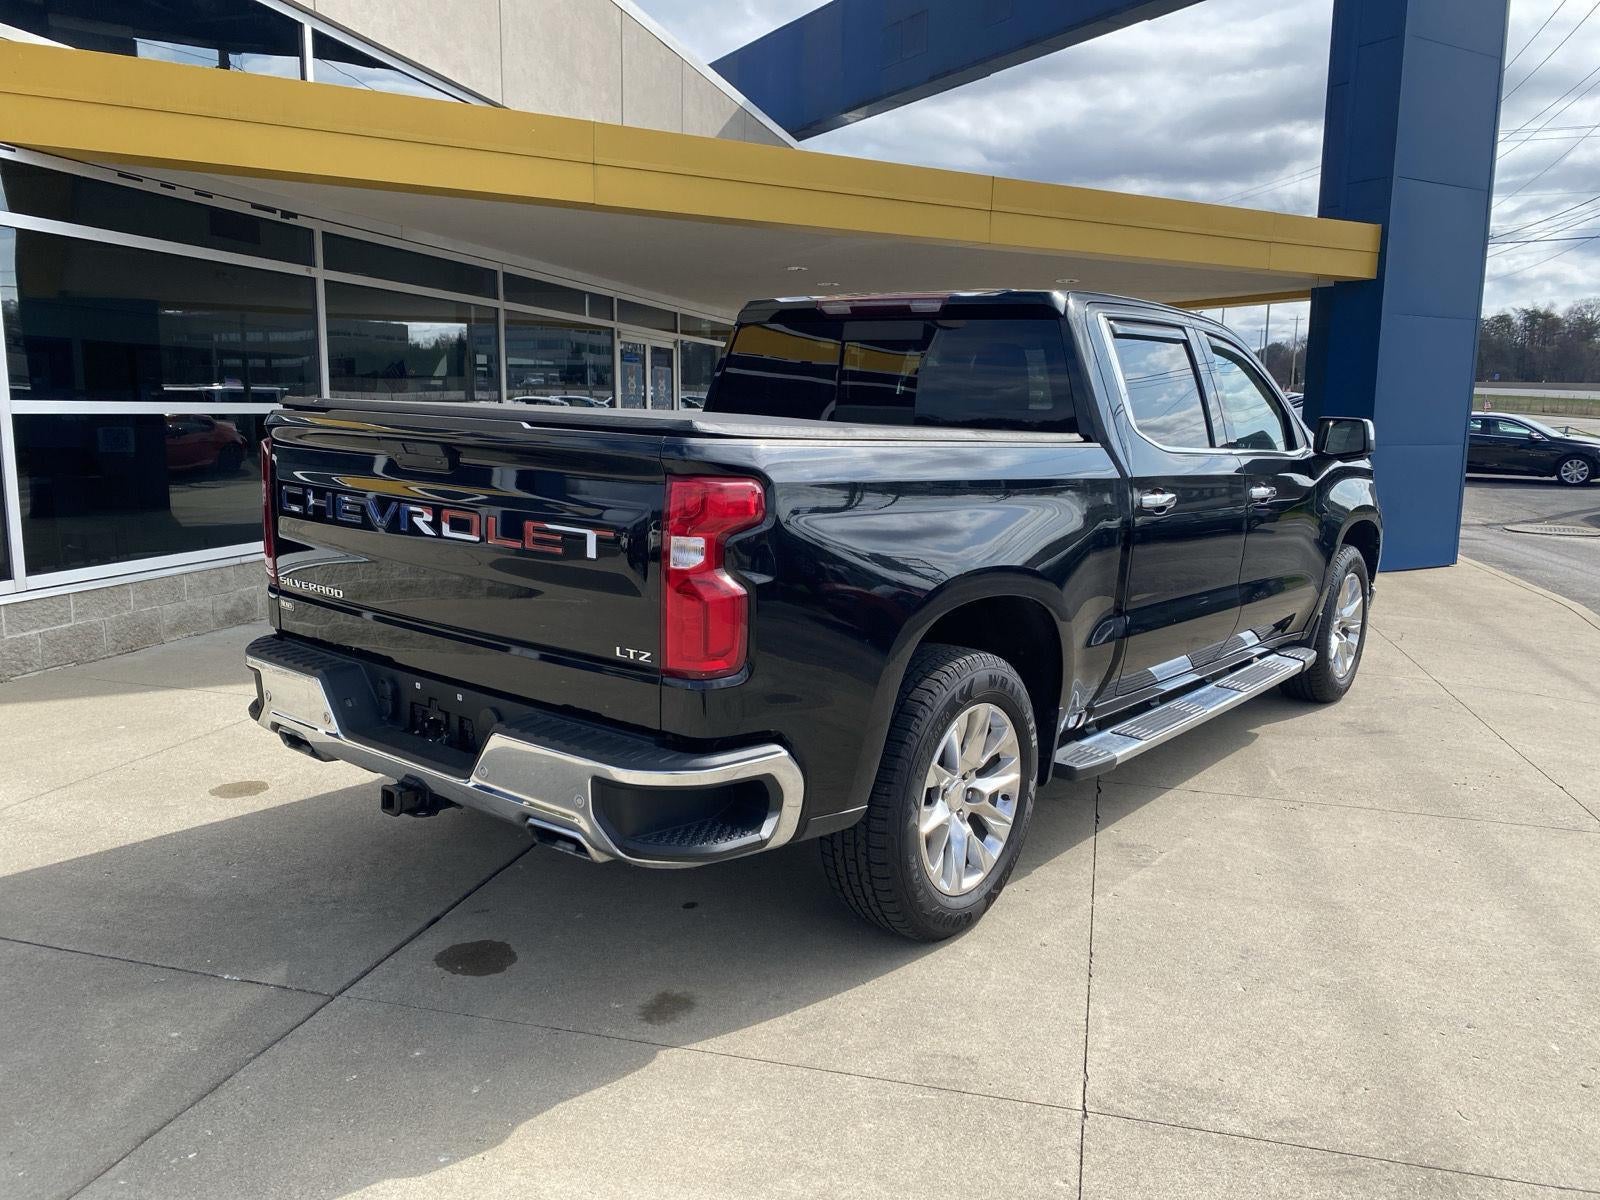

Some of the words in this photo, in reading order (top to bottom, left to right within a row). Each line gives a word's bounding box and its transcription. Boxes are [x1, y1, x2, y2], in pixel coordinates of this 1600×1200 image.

[282, 485, 615, 559] CHEVROLET
[279, 576, 344, 599] SILVERADO
[615, 646, 652, 663] LTZ
